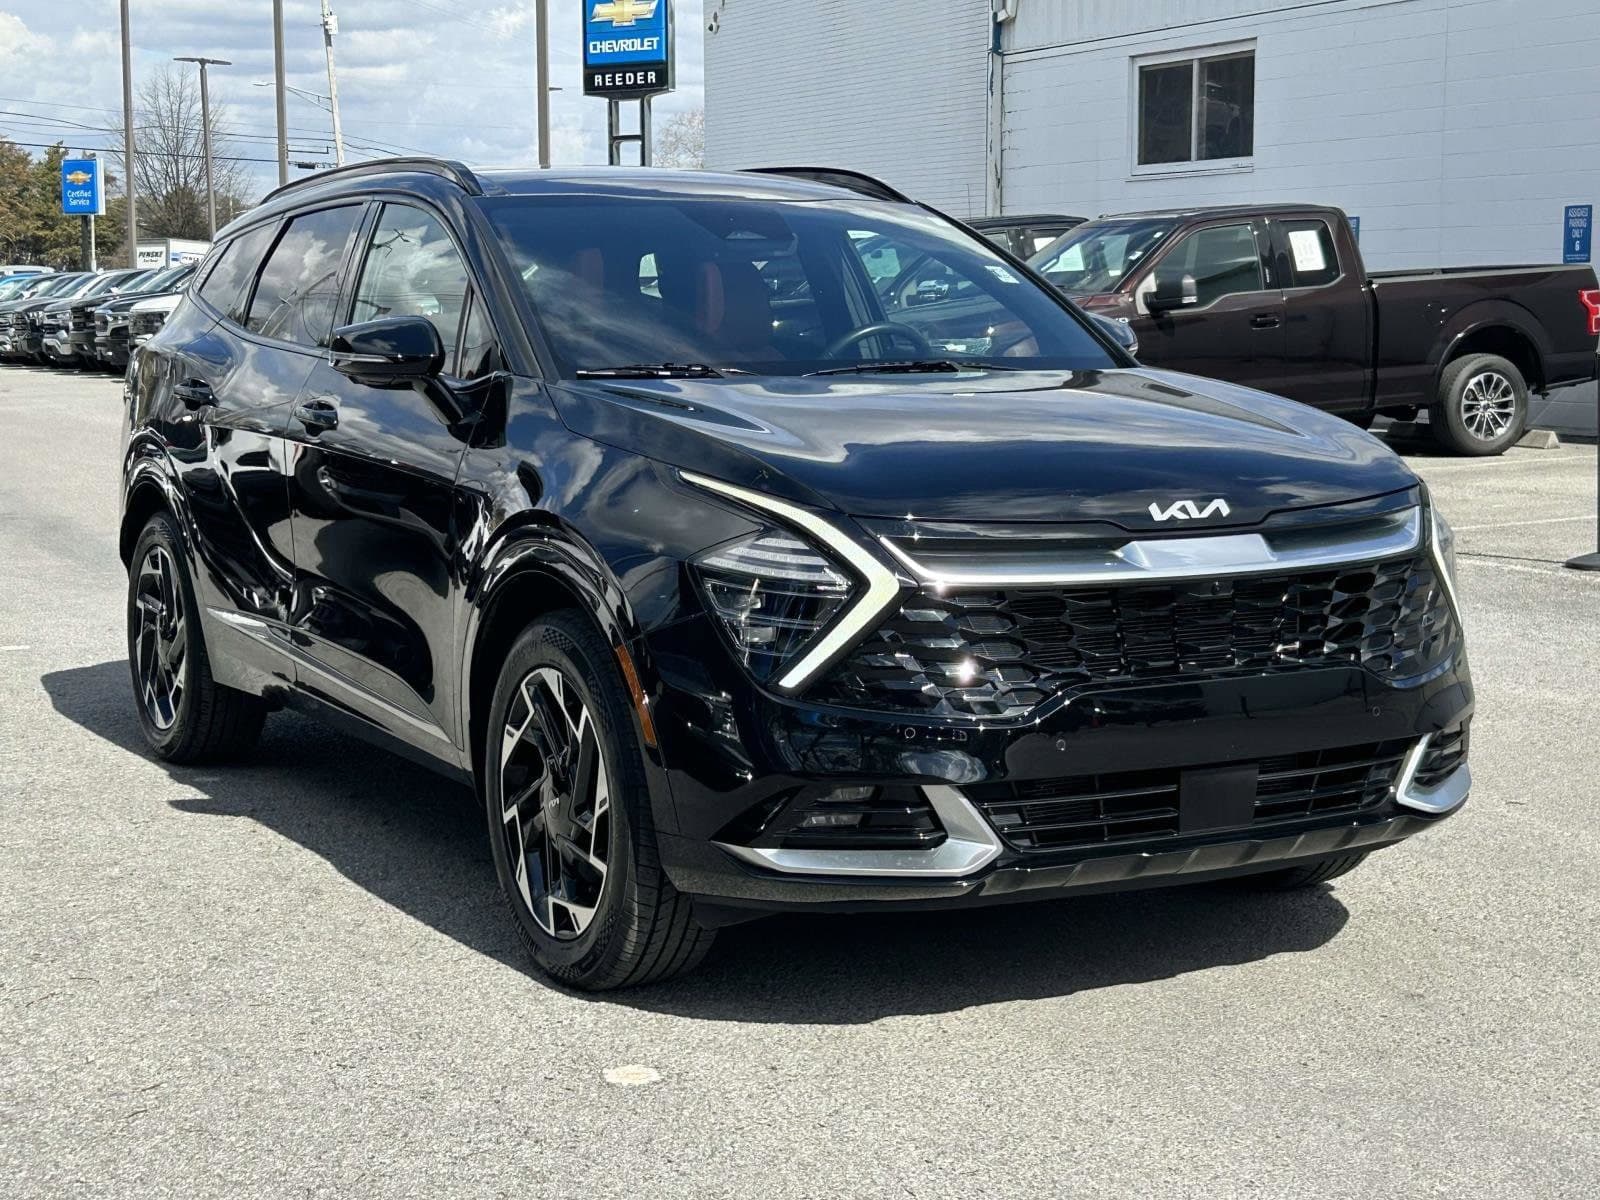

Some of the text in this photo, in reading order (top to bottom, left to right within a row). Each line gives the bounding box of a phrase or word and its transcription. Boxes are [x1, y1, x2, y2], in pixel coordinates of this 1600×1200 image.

[589, 37, 660, 54] CHEVROLET
[594, 71, 657, 87] REEDER
[67, 190, 92, 198] Certified
[69, 198, 90, 206] Service
[1148, 498, 1231, 522] KIA
